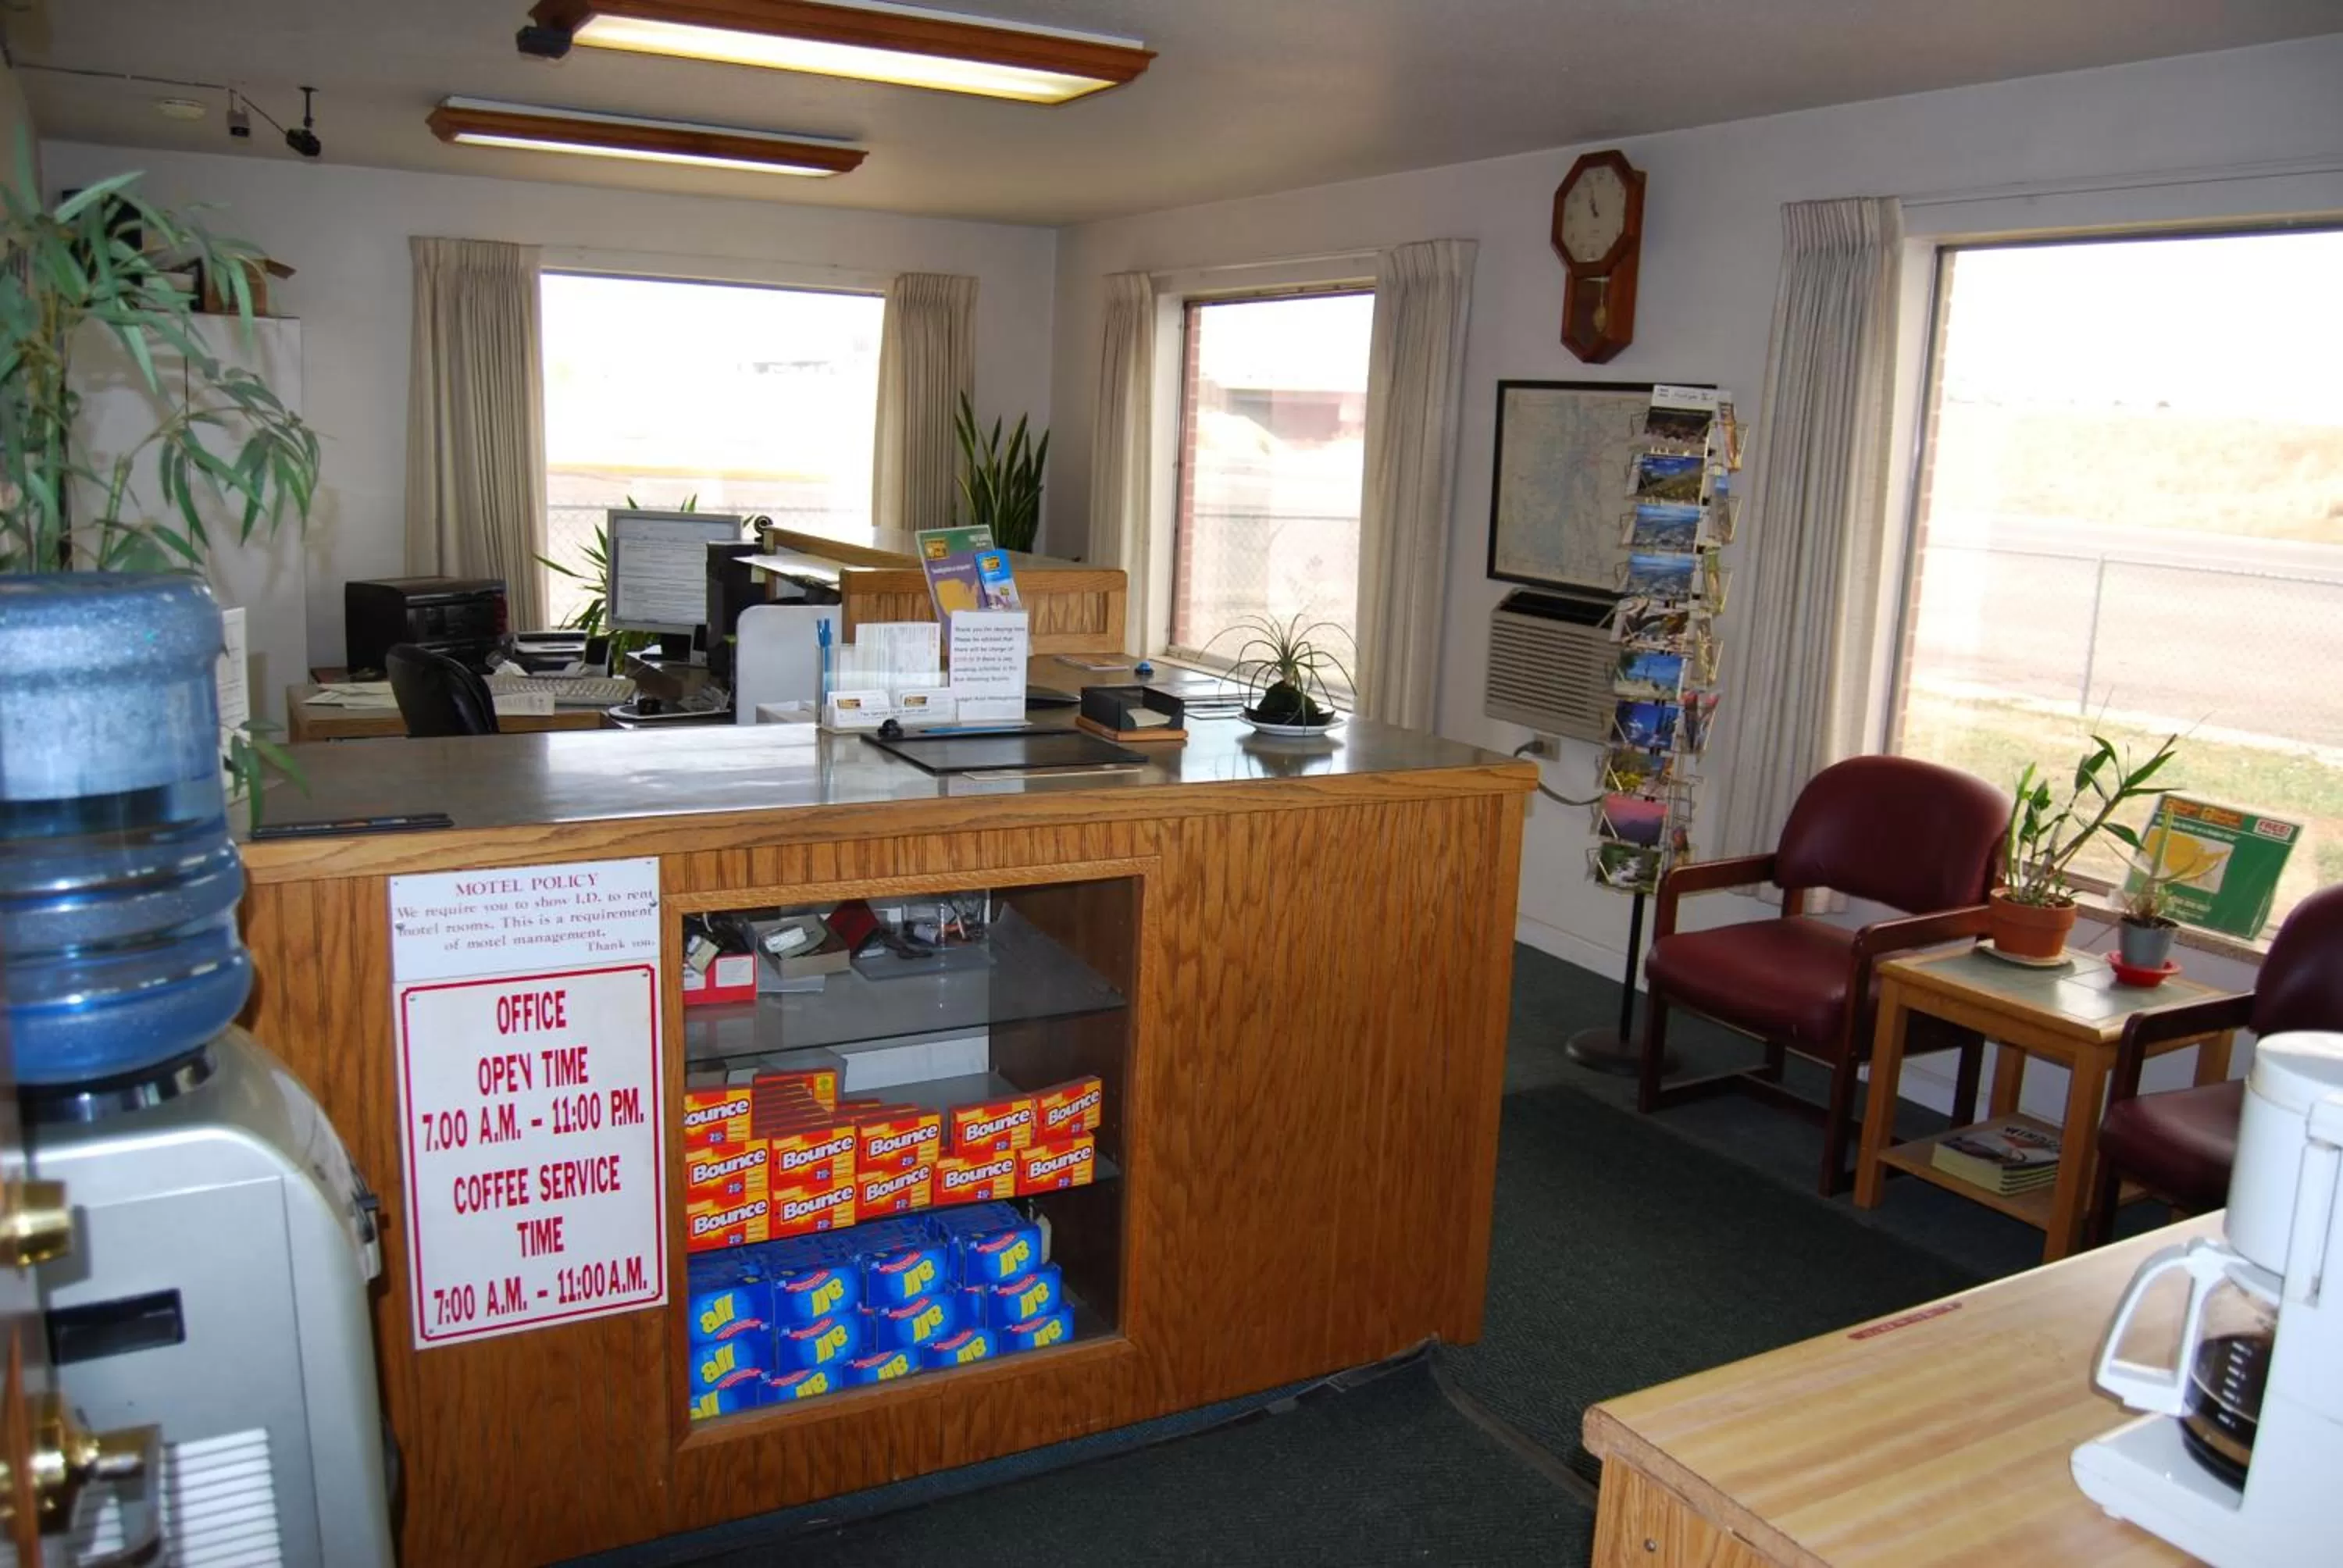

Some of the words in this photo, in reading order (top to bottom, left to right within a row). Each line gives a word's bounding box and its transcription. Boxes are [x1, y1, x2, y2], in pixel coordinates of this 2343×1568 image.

[455, 878, 522, 896] MOTEL
[531, 872, 598, 891] POLICY
[397, 907, 419, 918] We
[426, 902, 476, 918] require
[483, 901, 508, 913] you
[515, 900, 529, 910] to
[534, 896, 567, 908] show
[576, 892, 602, 904] I.D.
[608, 892, 622, 902] to
[627, 889, 653, 900] rent
[398, 922, 438, 937] motel
[446, 921, 494, 934] rooms.
[502, 915, 533, 928] This
[540, 913, 550, 925] is
[556, 914, 563, 925] a
[570, 907, 652, 924] requirement
[444, 938, 461, 950] of
[468, 935, 507, 950] motel
[513, 927, 607, 945] management.
[587, 938, 626, 952] Thank
[497, 989, 567, 1035] OFFICE
[478, 1052, 532, 1096] OPEN
[541, 1046, 589, 1088] TIME
[480, 1103, 522, 1146] A.M.
[552, 1091, 601, 1135] 11:00
[610, 1086, 645, 1127] P.M.
[965, 1108, 1031, 1141] Bounce
[1047, 1089, 1100, 1126] Bounce
[782, 1135, 854, 1170] Bounce
[869, 1124, 938, 1156] Bounce
[692, 1148, 768, 1183] Bounce
[945, 1159, 1014, 1189] Bounce
[1029, 1146, 1092, 1179] Bounce
[454, 1167, 530, 1215] COFFEE
[540, 1154, 622, 1203] SERVICE
[865, 1166, 930, 1202] Bounce
[694, 1200, 768, 1235] Bounce
[783, 1186, 854, 1221] Bounce
[516, 1216, 565, 1258] TIME
[1000, 1240, 1029, 1278] all
[811, 1278, 844, 1318] all
[904, 1260, 935, 1299] all
[433, 1283, 476, 1325] 7:00
[487, 1274, 528, 1317] A.M.
[700, 1292, 735, 1334] all
[1020, 1282, 1050, 1319] all
[912, 1305, 943, 1344] all
[815, 1324, 848, 1364] all
[701, 1342, 736, 1384] all
